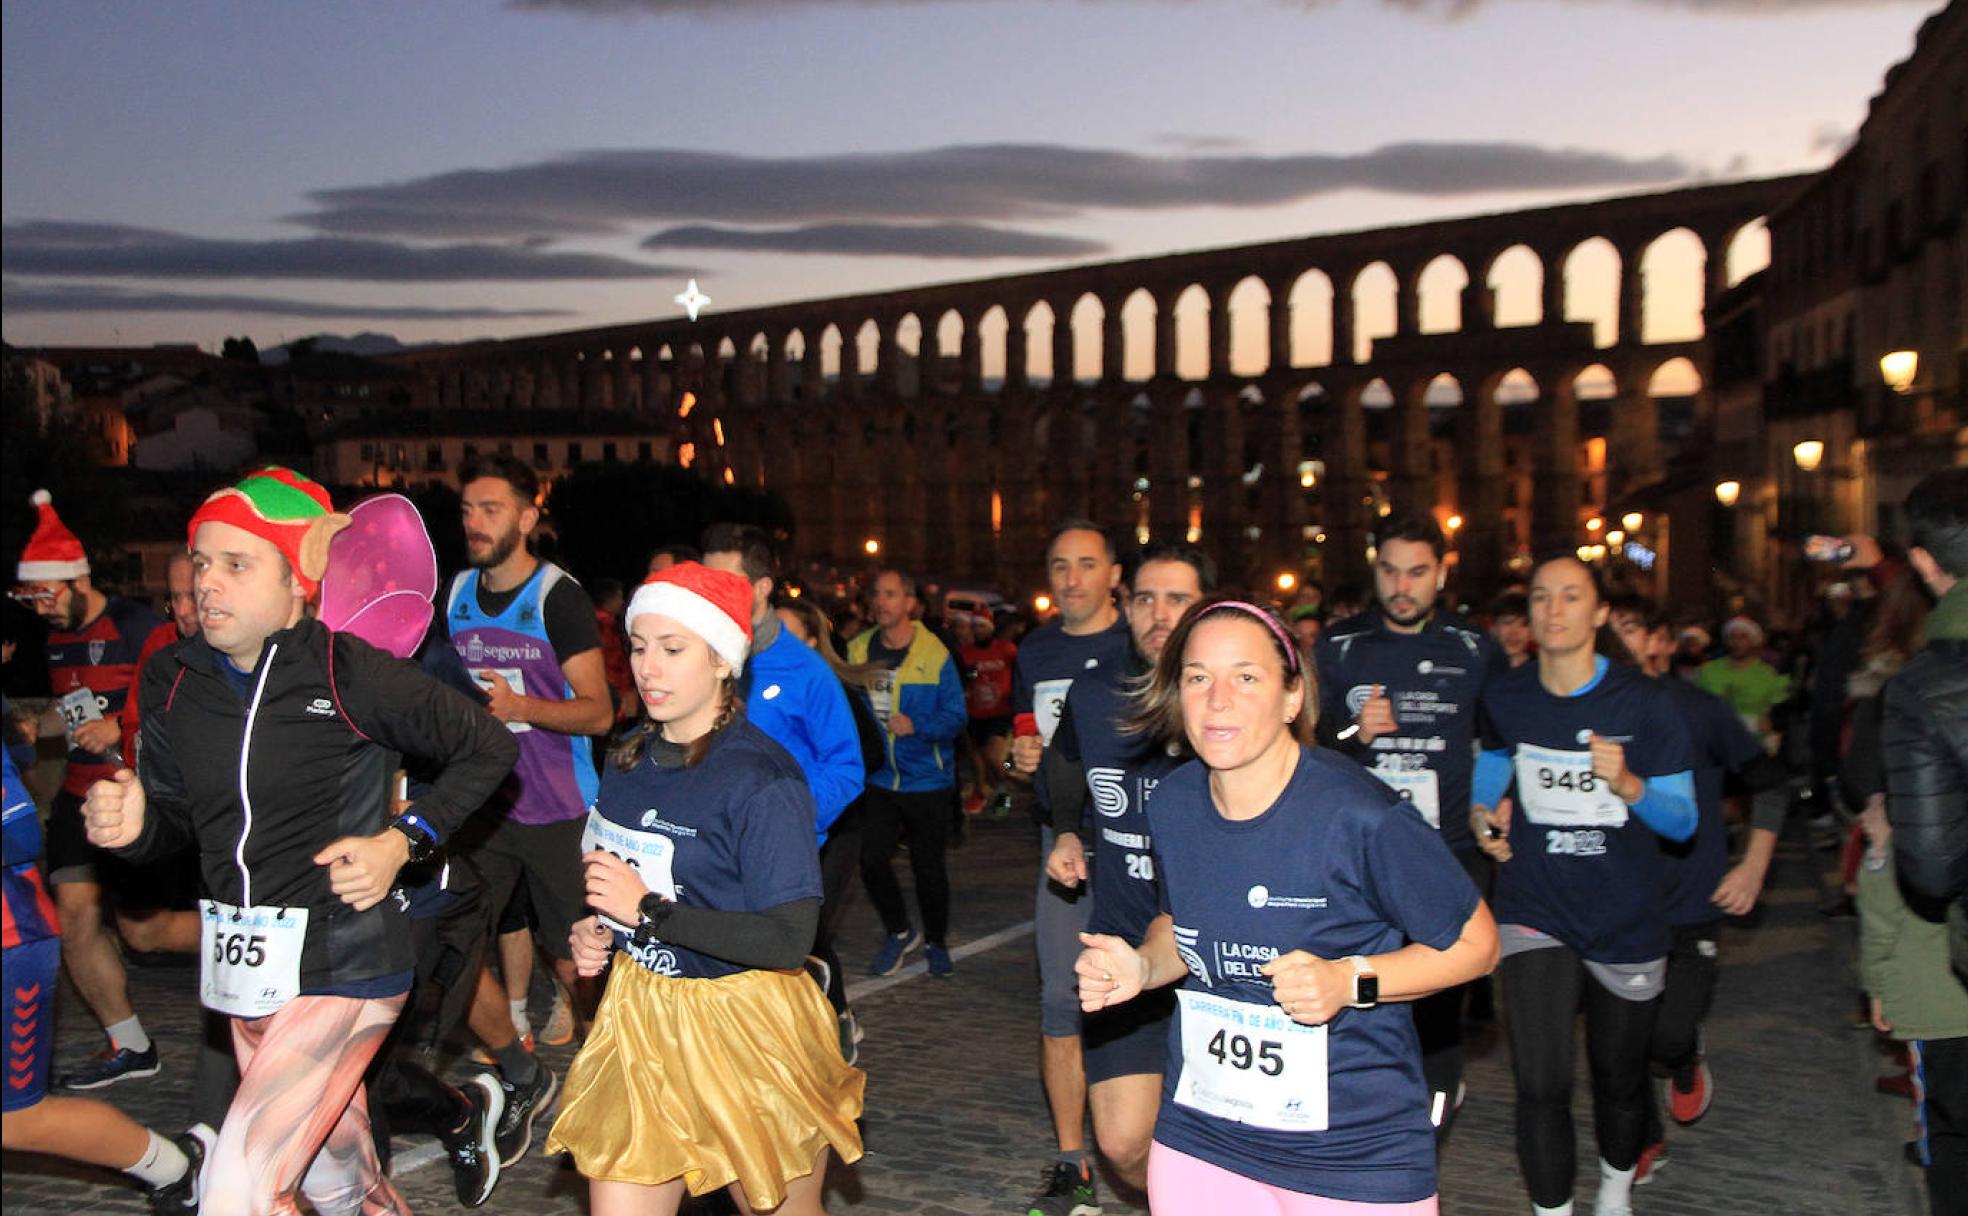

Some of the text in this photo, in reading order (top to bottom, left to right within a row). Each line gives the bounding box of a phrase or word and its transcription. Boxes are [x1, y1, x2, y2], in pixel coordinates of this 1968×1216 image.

[484, 643, 542, 662] segovia
[1538, 767, 1596, 792] 948
[1546, 830, 1607, 856] 2022
[1125, 853, 1155, 881] 20
[214, 932, 268, 968] 565
[1221, 941, 1280, 962] LA CASA
[1223, 961, 1250, 976] DEL
[1249, 1014, 1262, 1028] DE
[1207, 1028, 1285, 1077] 495
